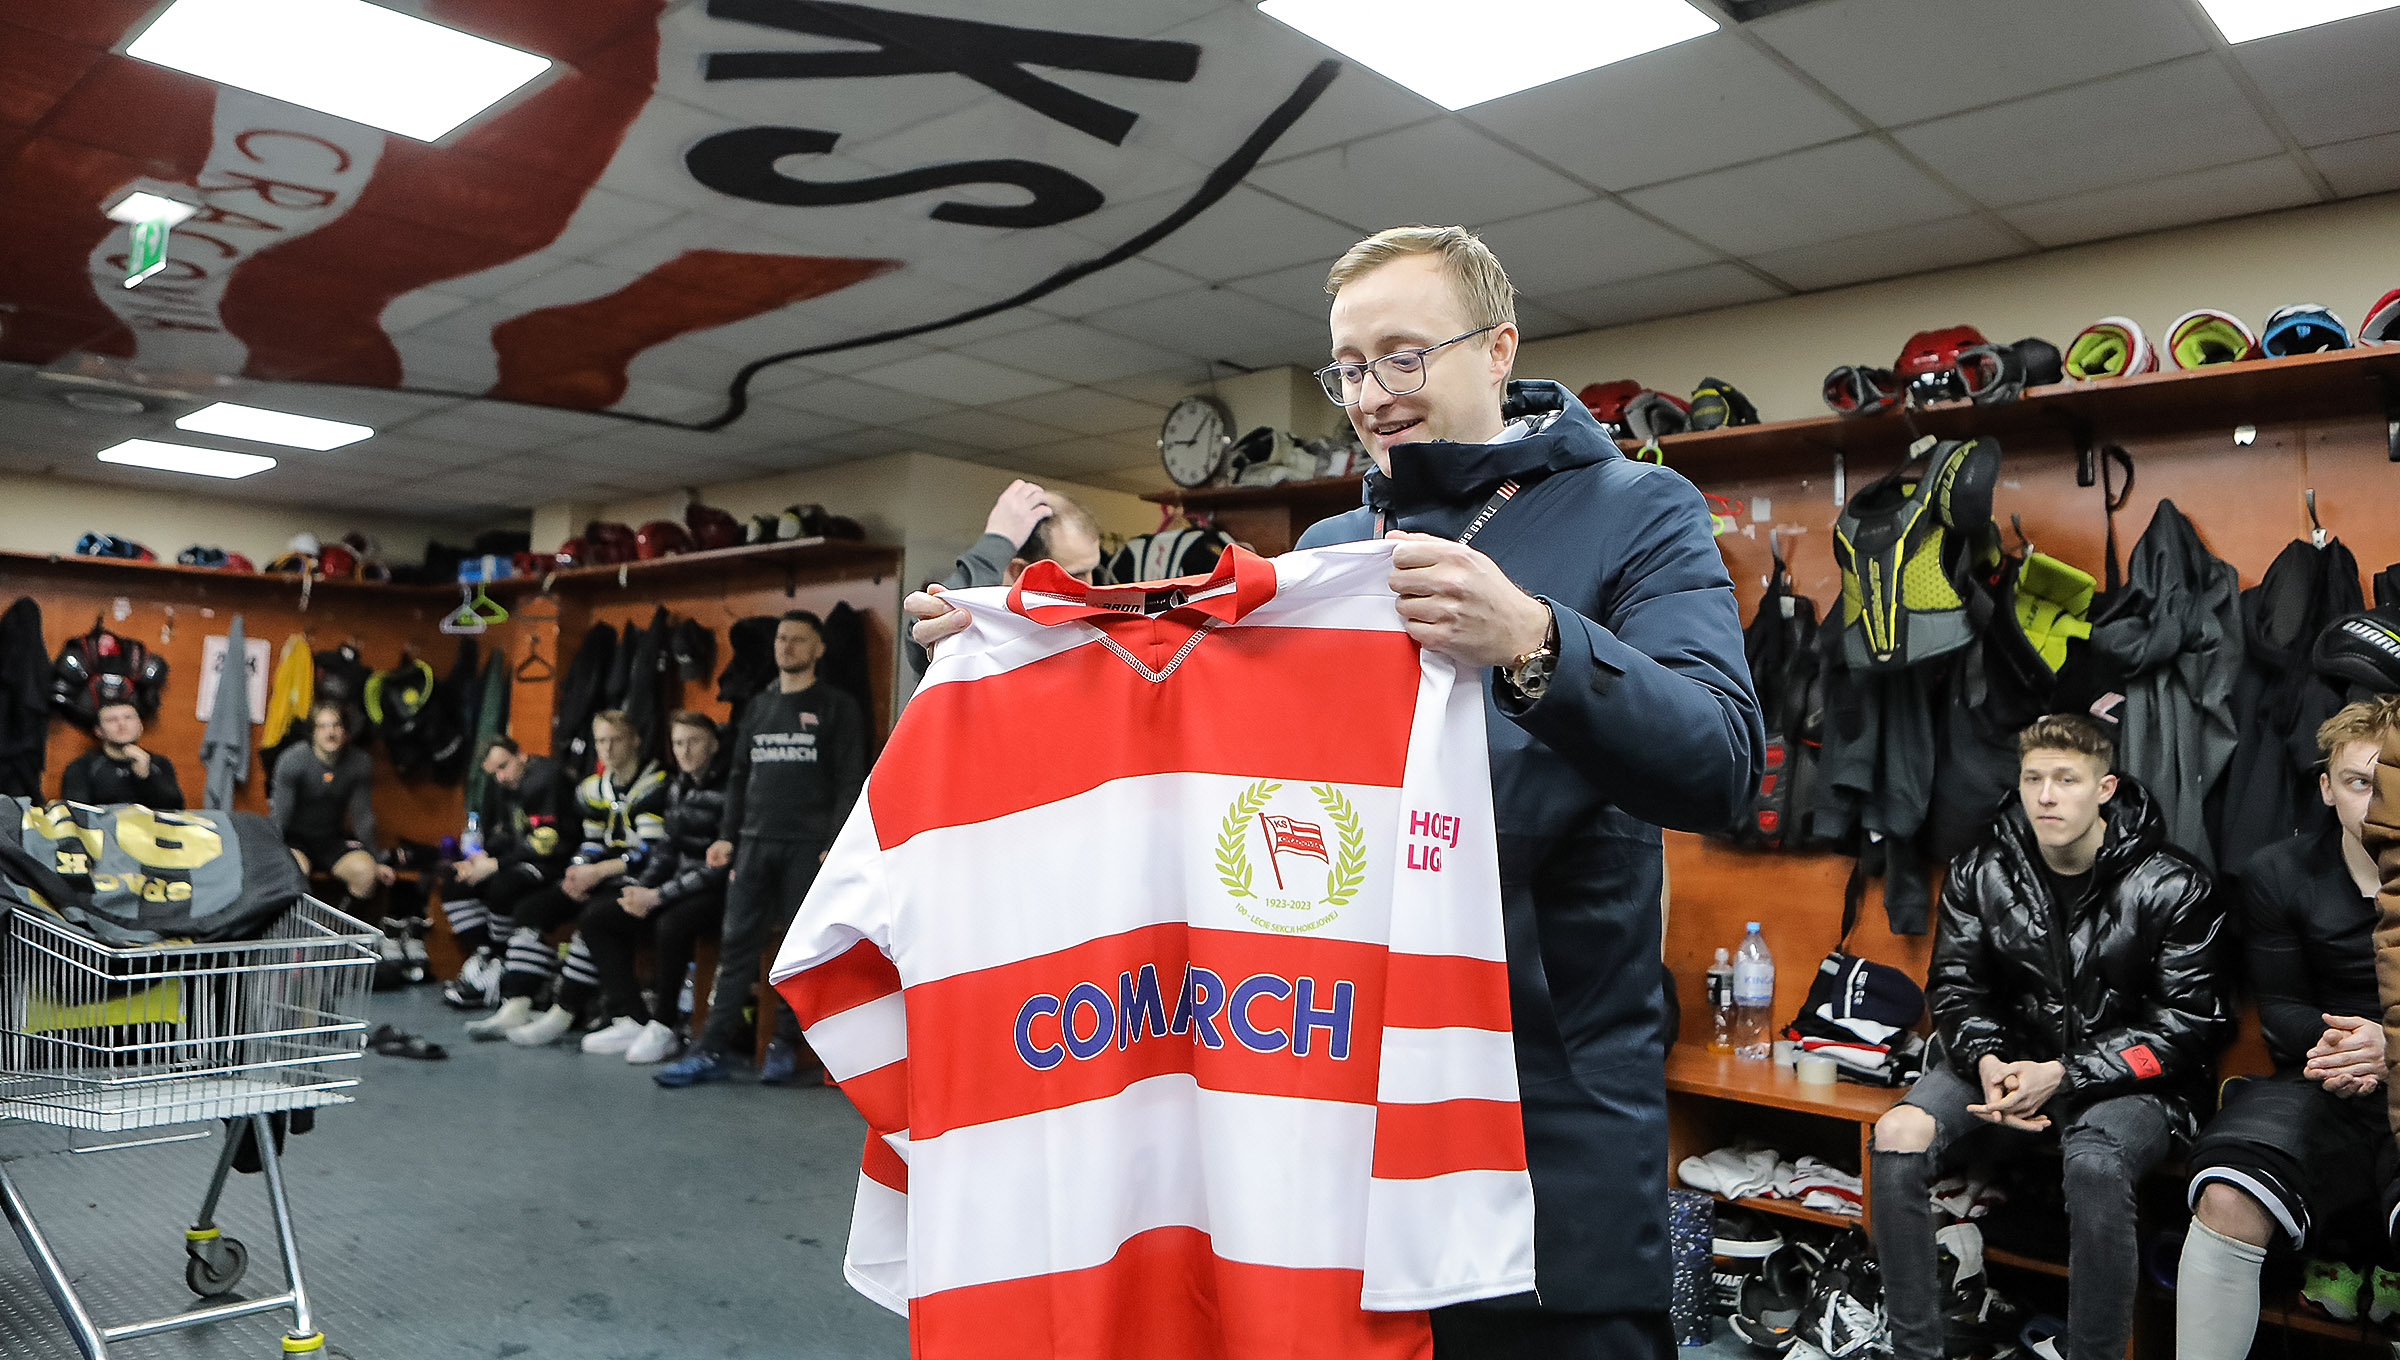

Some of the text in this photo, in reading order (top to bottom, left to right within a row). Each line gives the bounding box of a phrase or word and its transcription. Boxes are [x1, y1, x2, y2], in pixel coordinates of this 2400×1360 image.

[685, 0, 1202, 228] KS
[1469, 505, 1498, 533] TYLKO
[1274, 820, 1288, 829] KS
[1235, 903, 1248, 916] 100
[1250, 915, 1270, 929] LECIE
[1272, 923, 1295, 933] SEKCJI
[1296, 910, 1339, 933] HOKEJOWEJ
[1265, 898, 1311, 910] 1923-2023
[1014, 961, 1355, 1071] COMARCH
